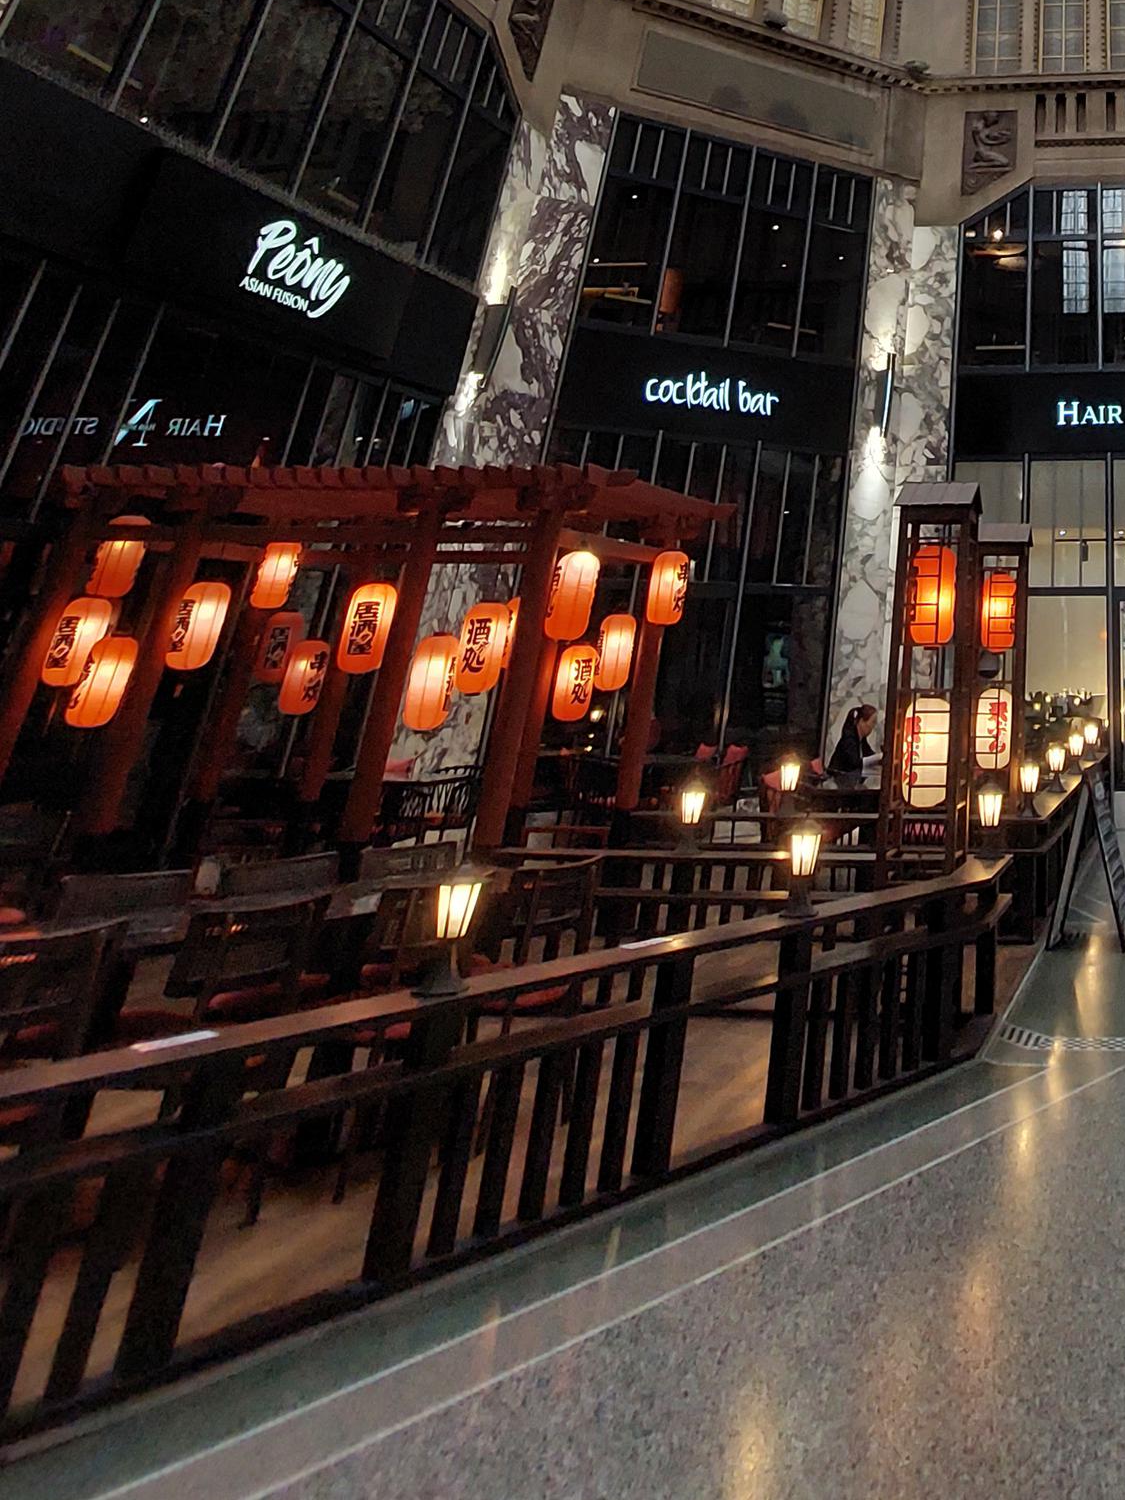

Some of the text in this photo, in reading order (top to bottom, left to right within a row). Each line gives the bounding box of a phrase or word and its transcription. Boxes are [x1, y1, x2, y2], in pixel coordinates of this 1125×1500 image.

[239, 276, 309, 311] ASIAN FUSION
[645, 371, 779, 415] cocktail bar
